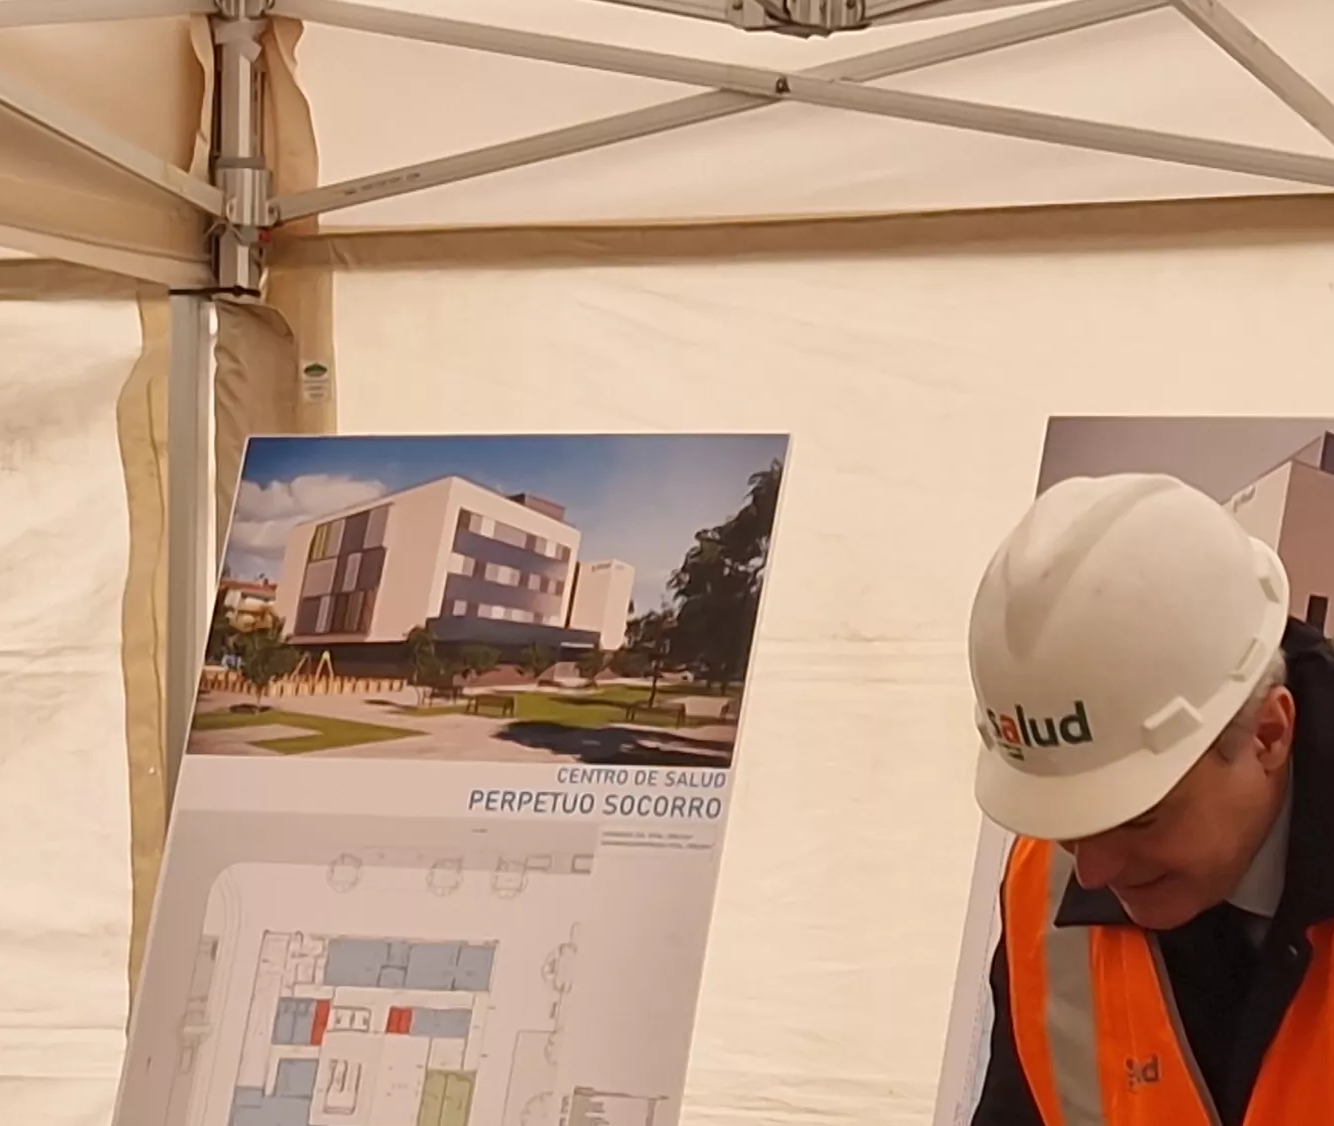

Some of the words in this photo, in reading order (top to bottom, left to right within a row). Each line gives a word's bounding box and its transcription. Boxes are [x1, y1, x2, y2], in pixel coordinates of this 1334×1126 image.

[987, 699, 1093, 749] salud
[557, 767, 629, 786] CENTRO
[634, 769, 658, 787] DE
[664, 770, 727, 788] SALUD
[468, 789, 595, 815] PERPETUO
[602, 793, 722, 819] SOCORRO
